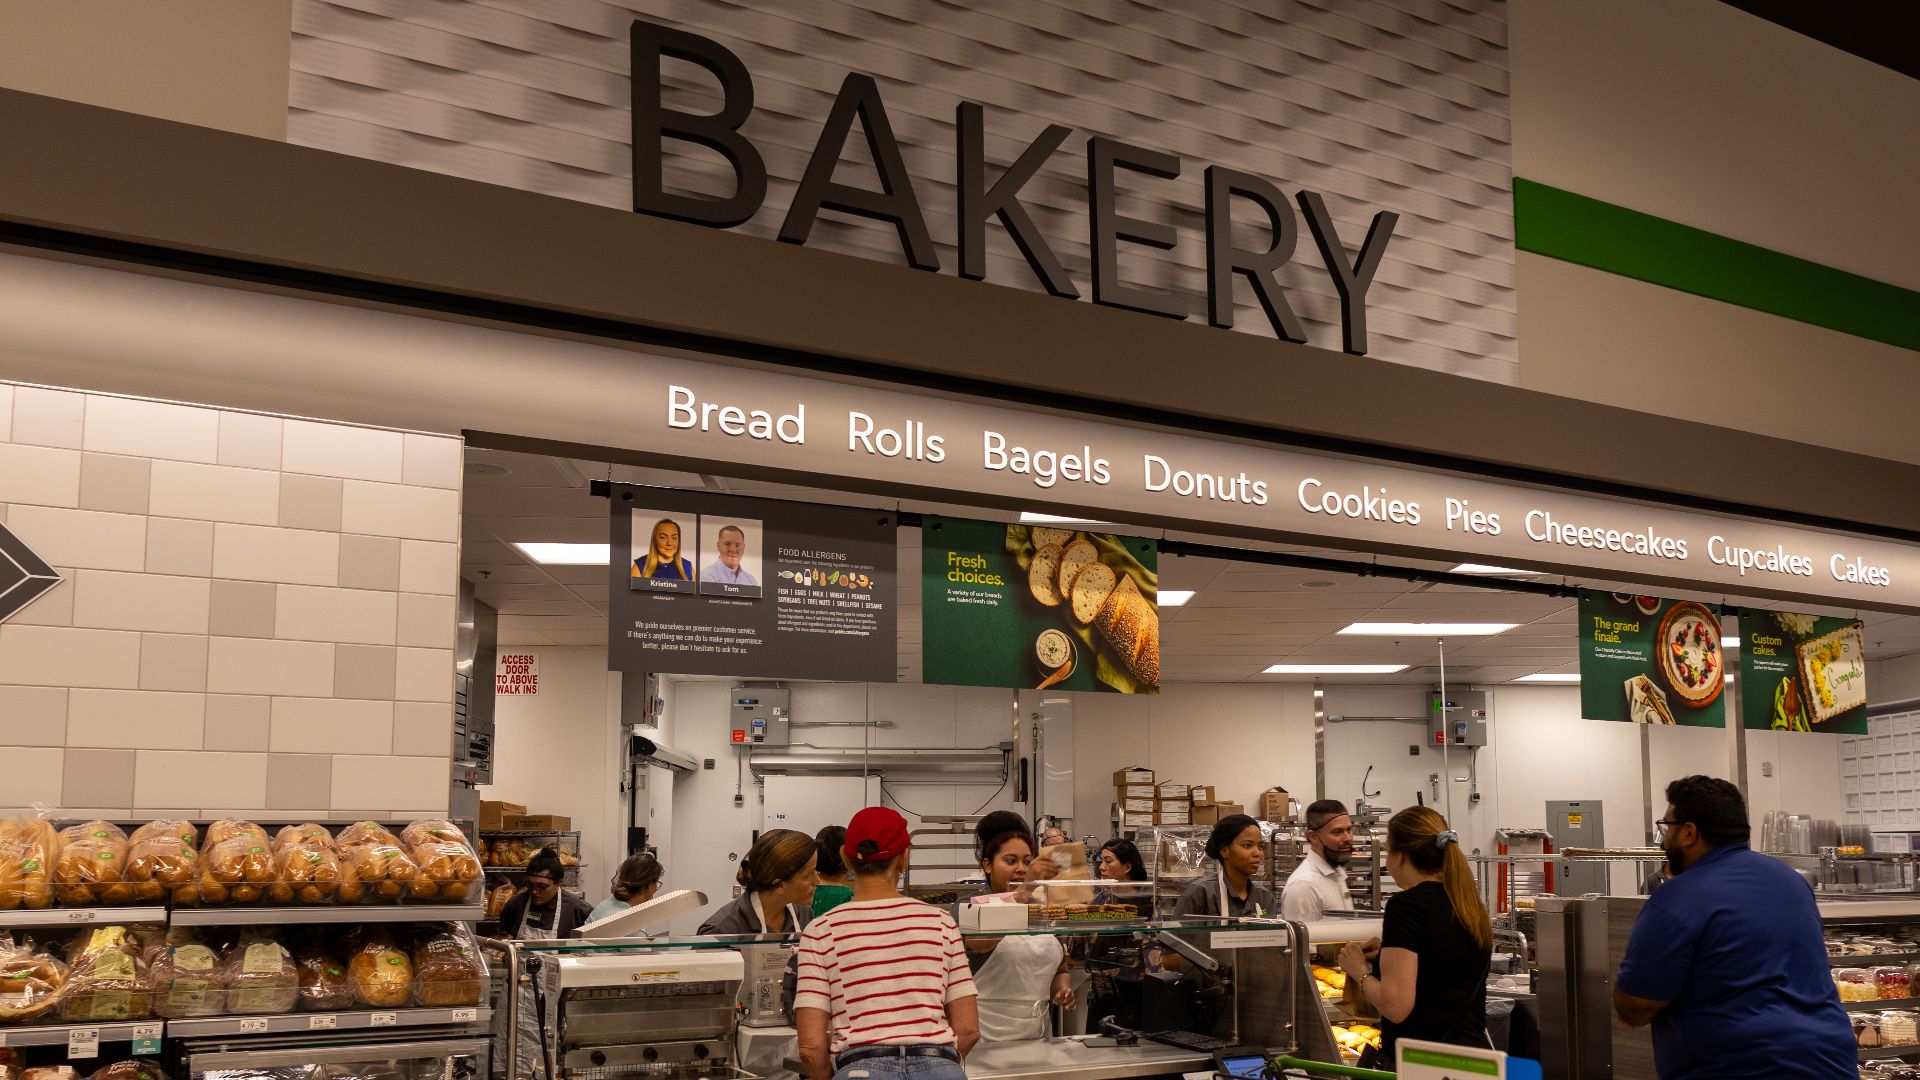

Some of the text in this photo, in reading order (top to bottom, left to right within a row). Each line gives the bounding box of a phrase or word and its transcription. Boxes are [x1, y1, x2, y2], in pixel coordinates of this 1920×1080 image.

[630, 19, 1399, 355] BAKERY
[667, 385, 1890, 587] Bread Rolls Bagels Donuts Cookies Pies Cheesecakes Cupcakes Cakes
[778, 548, 847, 561] FOOD ALLERGENS
[948, 551, 987, 569] Fresh
[947, 567, 1005, 586] choices.
[650, 580, 677, 588] Kristina
[723, 585, 740, 593] Tom
[794, 589, 807, 597] EGGS
[812, 590, 824, 598] MILK
[829, 591, 845, 599] WHEAT
[851, 593, 871, 601] PEANUTS
[778, 596, 802, 604] SOYBEANS
[836, 600, 860, 608] SHELLFISH
[865, 602, 883, 610] SESAME
[635, 620, 644, 628] We
[645, 622, 658, 630] pride
[1594, 616, 1639, 634] The grand
[633, 631, 652, 639] there's
[653, 632, 674, 641] anything
[1594, 630, 1622, 643] finale.
[1751, 633, 1782, 646] Custom
[661, 643, 678, 651] please
[679, 643, 693, 651] don't
[693, 644, 714, 652] hesitate
[1752, 645, 1776, 656] cakes.
[501, 655, 534, 664] ACCESS
[506, 665, 529, 674] DOOR
[497, 675, 538, 684] TO ABOVE
[497, 685, 537, 694] WALK INS
